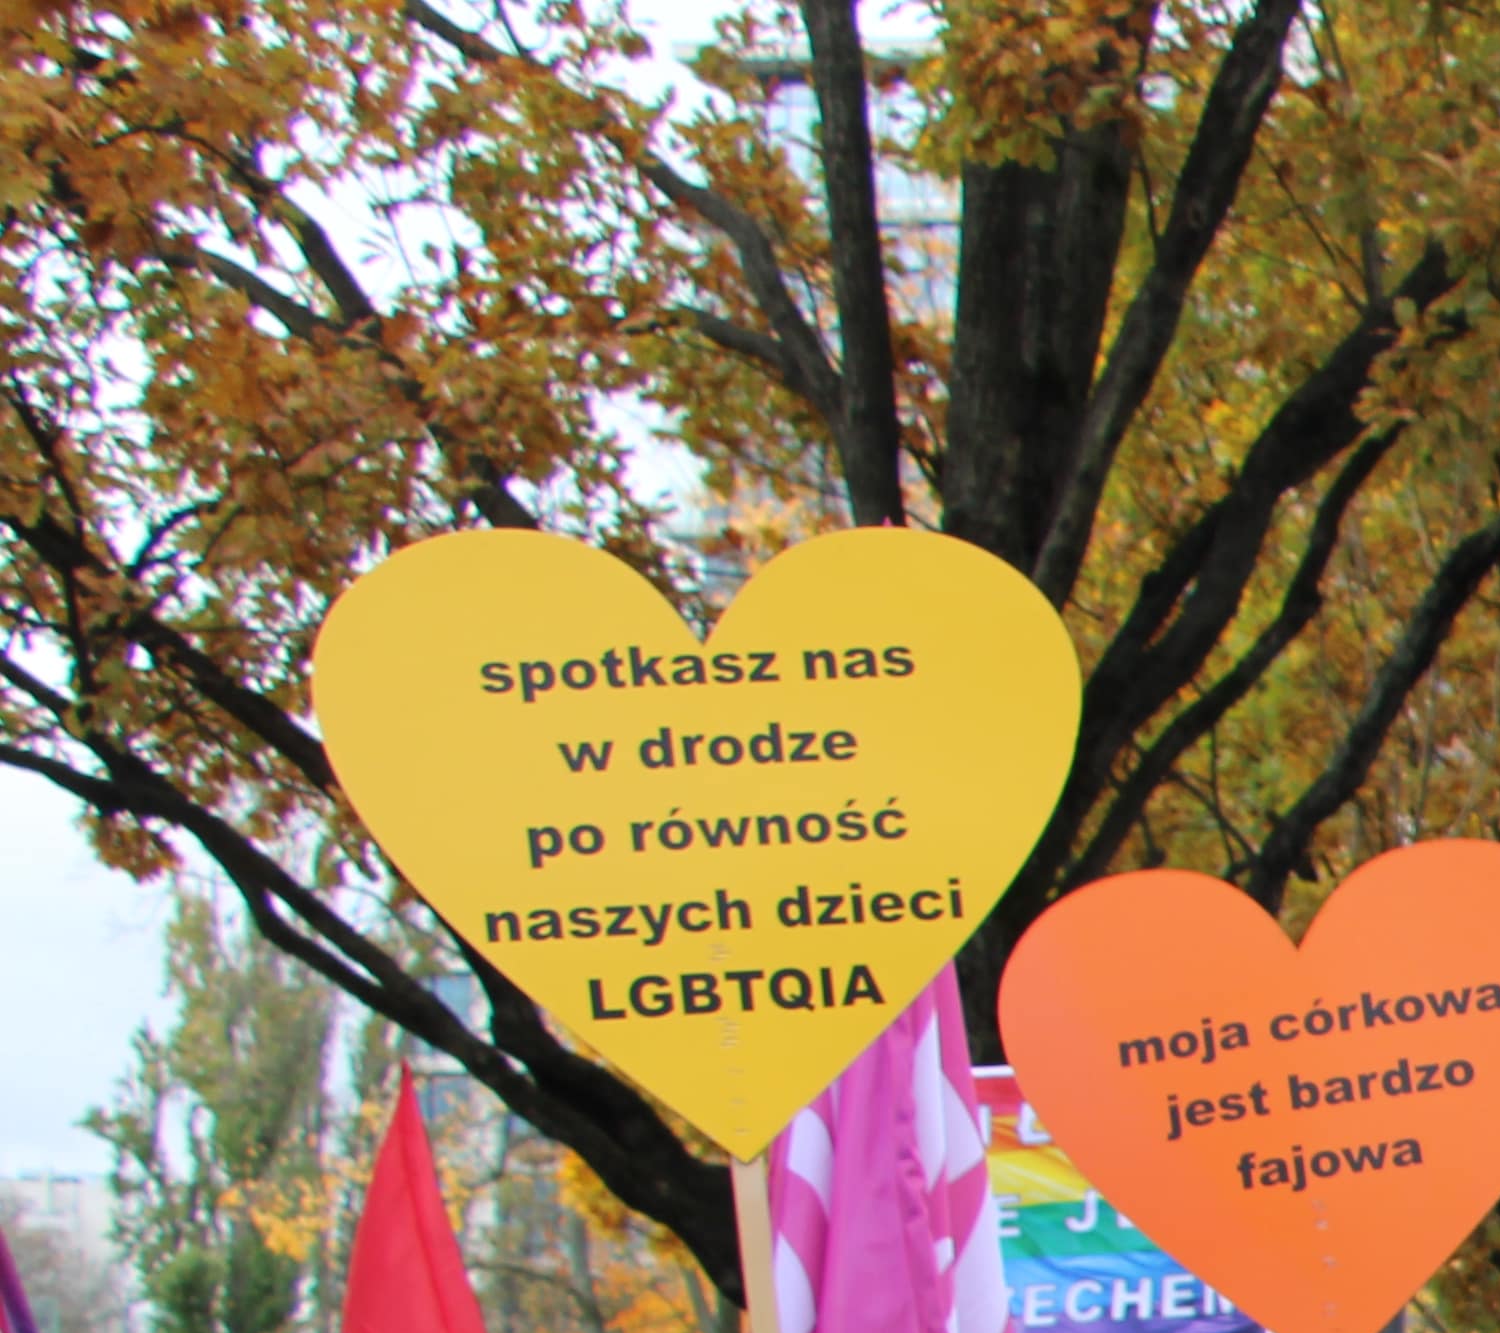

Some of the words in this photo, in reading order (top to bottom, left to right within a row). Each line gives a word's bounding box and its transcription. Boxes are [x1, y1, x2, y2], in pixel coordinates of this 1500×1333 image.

[481, 646, 778, 702] spotkasz
[803, 647, 913, 679] nas
[558, 741, 611, 771] w
[639, 723, 855, 768] drodze
[527, 825, 602, 868] po
[631, 810, 905, 851] równość
[485, 890, 750, 945] naszych
[777, 878, 961, 927] dzieci
[588, 965, 883, 1019] LGBTQIA
[1120, 1019, 1248, 1066] moja
[1168, 1084, 1268, 1140] jest
[1289, 1059, 1473, 1109] bardzo
[1238, 1139, 1421, 1191] fajowa
